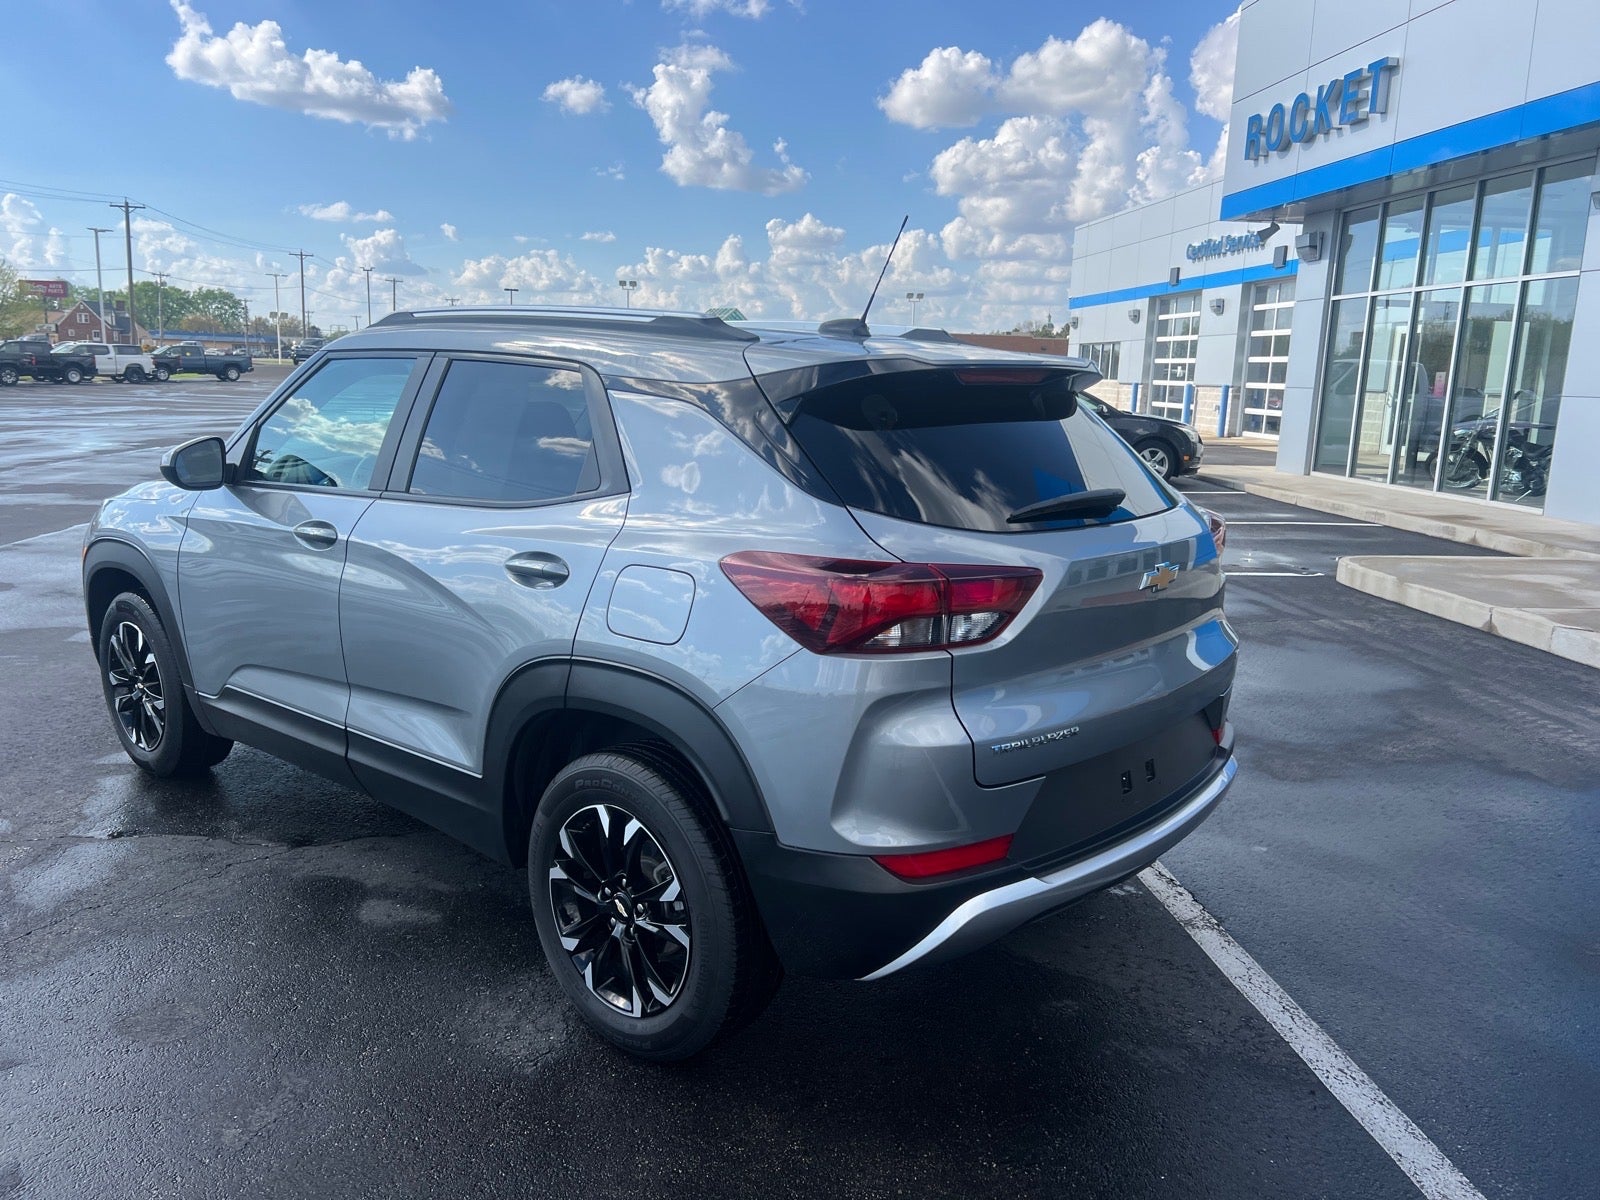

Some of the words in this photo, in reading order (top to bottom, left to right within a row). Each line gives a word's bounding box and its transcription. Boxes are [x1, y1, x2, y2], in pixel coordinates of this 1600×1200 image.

[1244, 57, 1398, 160] ROCKET
[1186, 236, 1224, 260] Certified
[1225, 232, 1262, 253] Service
[991, 726, 1080, 753] TRAILBLAZER
